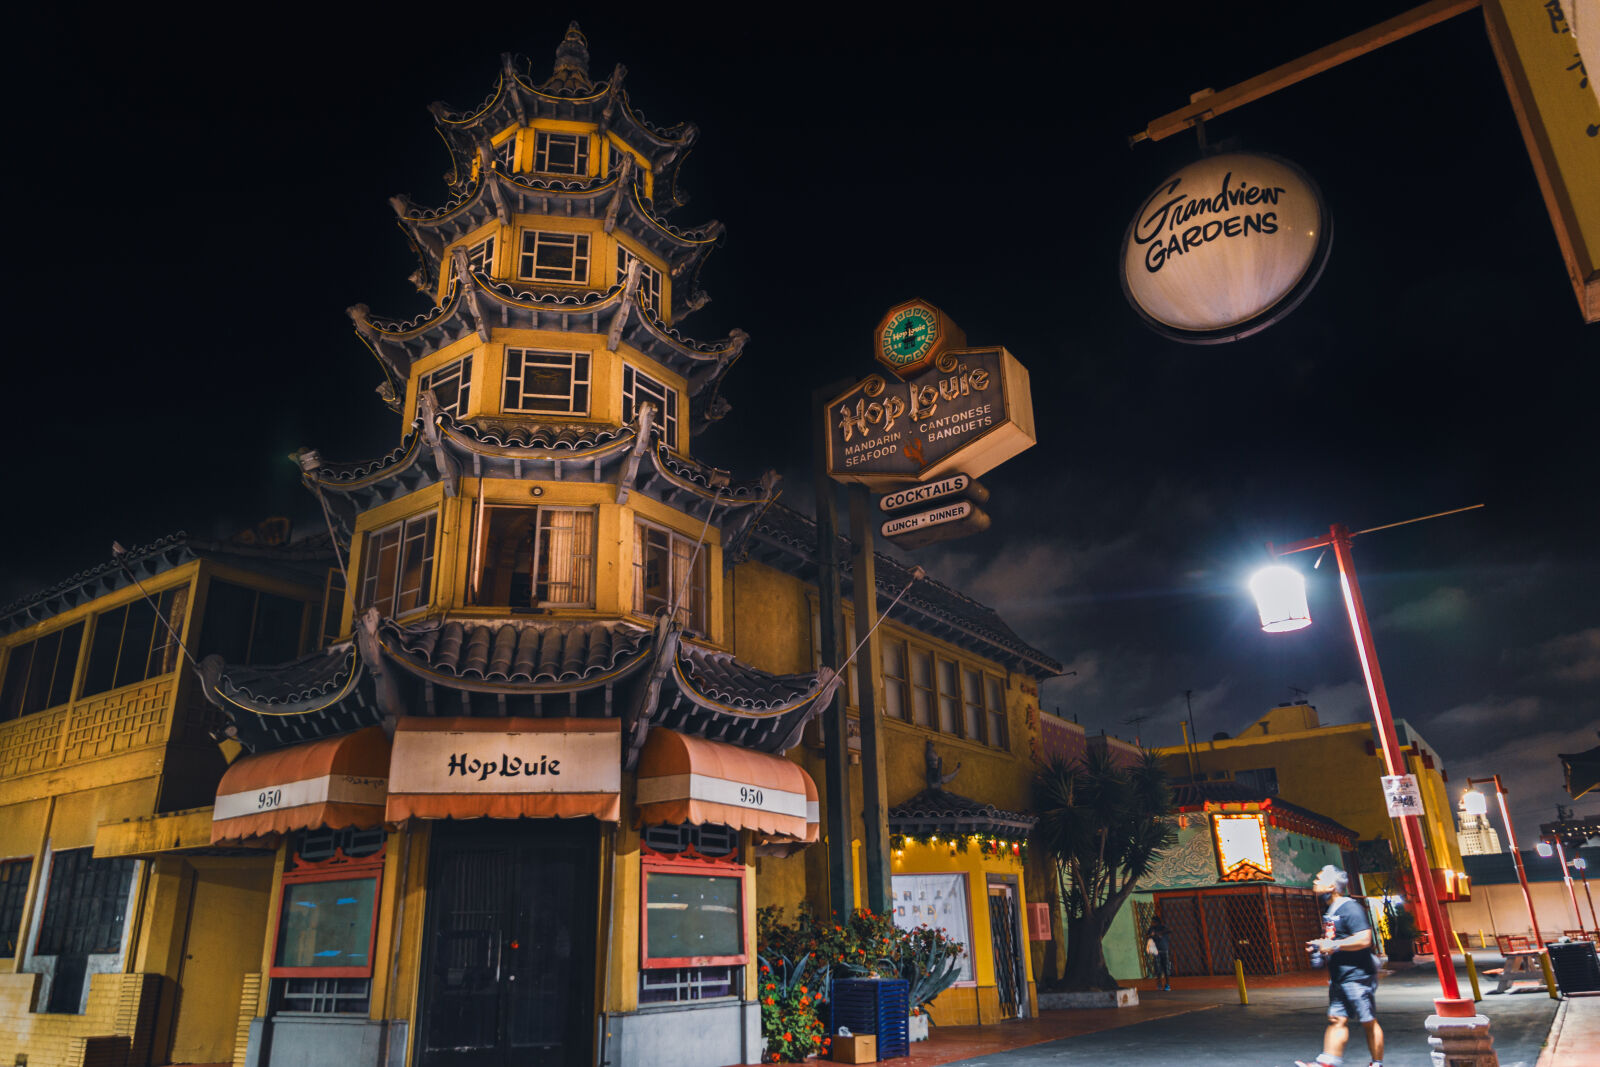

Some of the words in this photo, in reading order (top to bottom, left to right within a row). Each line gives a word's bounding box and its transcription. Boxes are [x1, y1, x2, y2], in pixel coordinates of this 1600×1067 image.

[1134, 171, 1286, 244] Grandview
[1145, 212, 1279, 273] GARDENS
[839, 398, 905, 442] Hop
[908, 363, 991, 422] Louie
[845, 431, 901, 456] MANDARIN
[919, 404, 992, 433] CANTONESE
[845, 445, 897, 467] SEAFOOD
[928, 416, 993, 443] BANQUETS
[885, 478, 964, 508] COCKTAILS
[887, 517, 919, 533] LUNCH
[929, 506, 965, 523] DINNER
[258, 789, 282, 809] 950
[740, 787, 763, 806] 950
